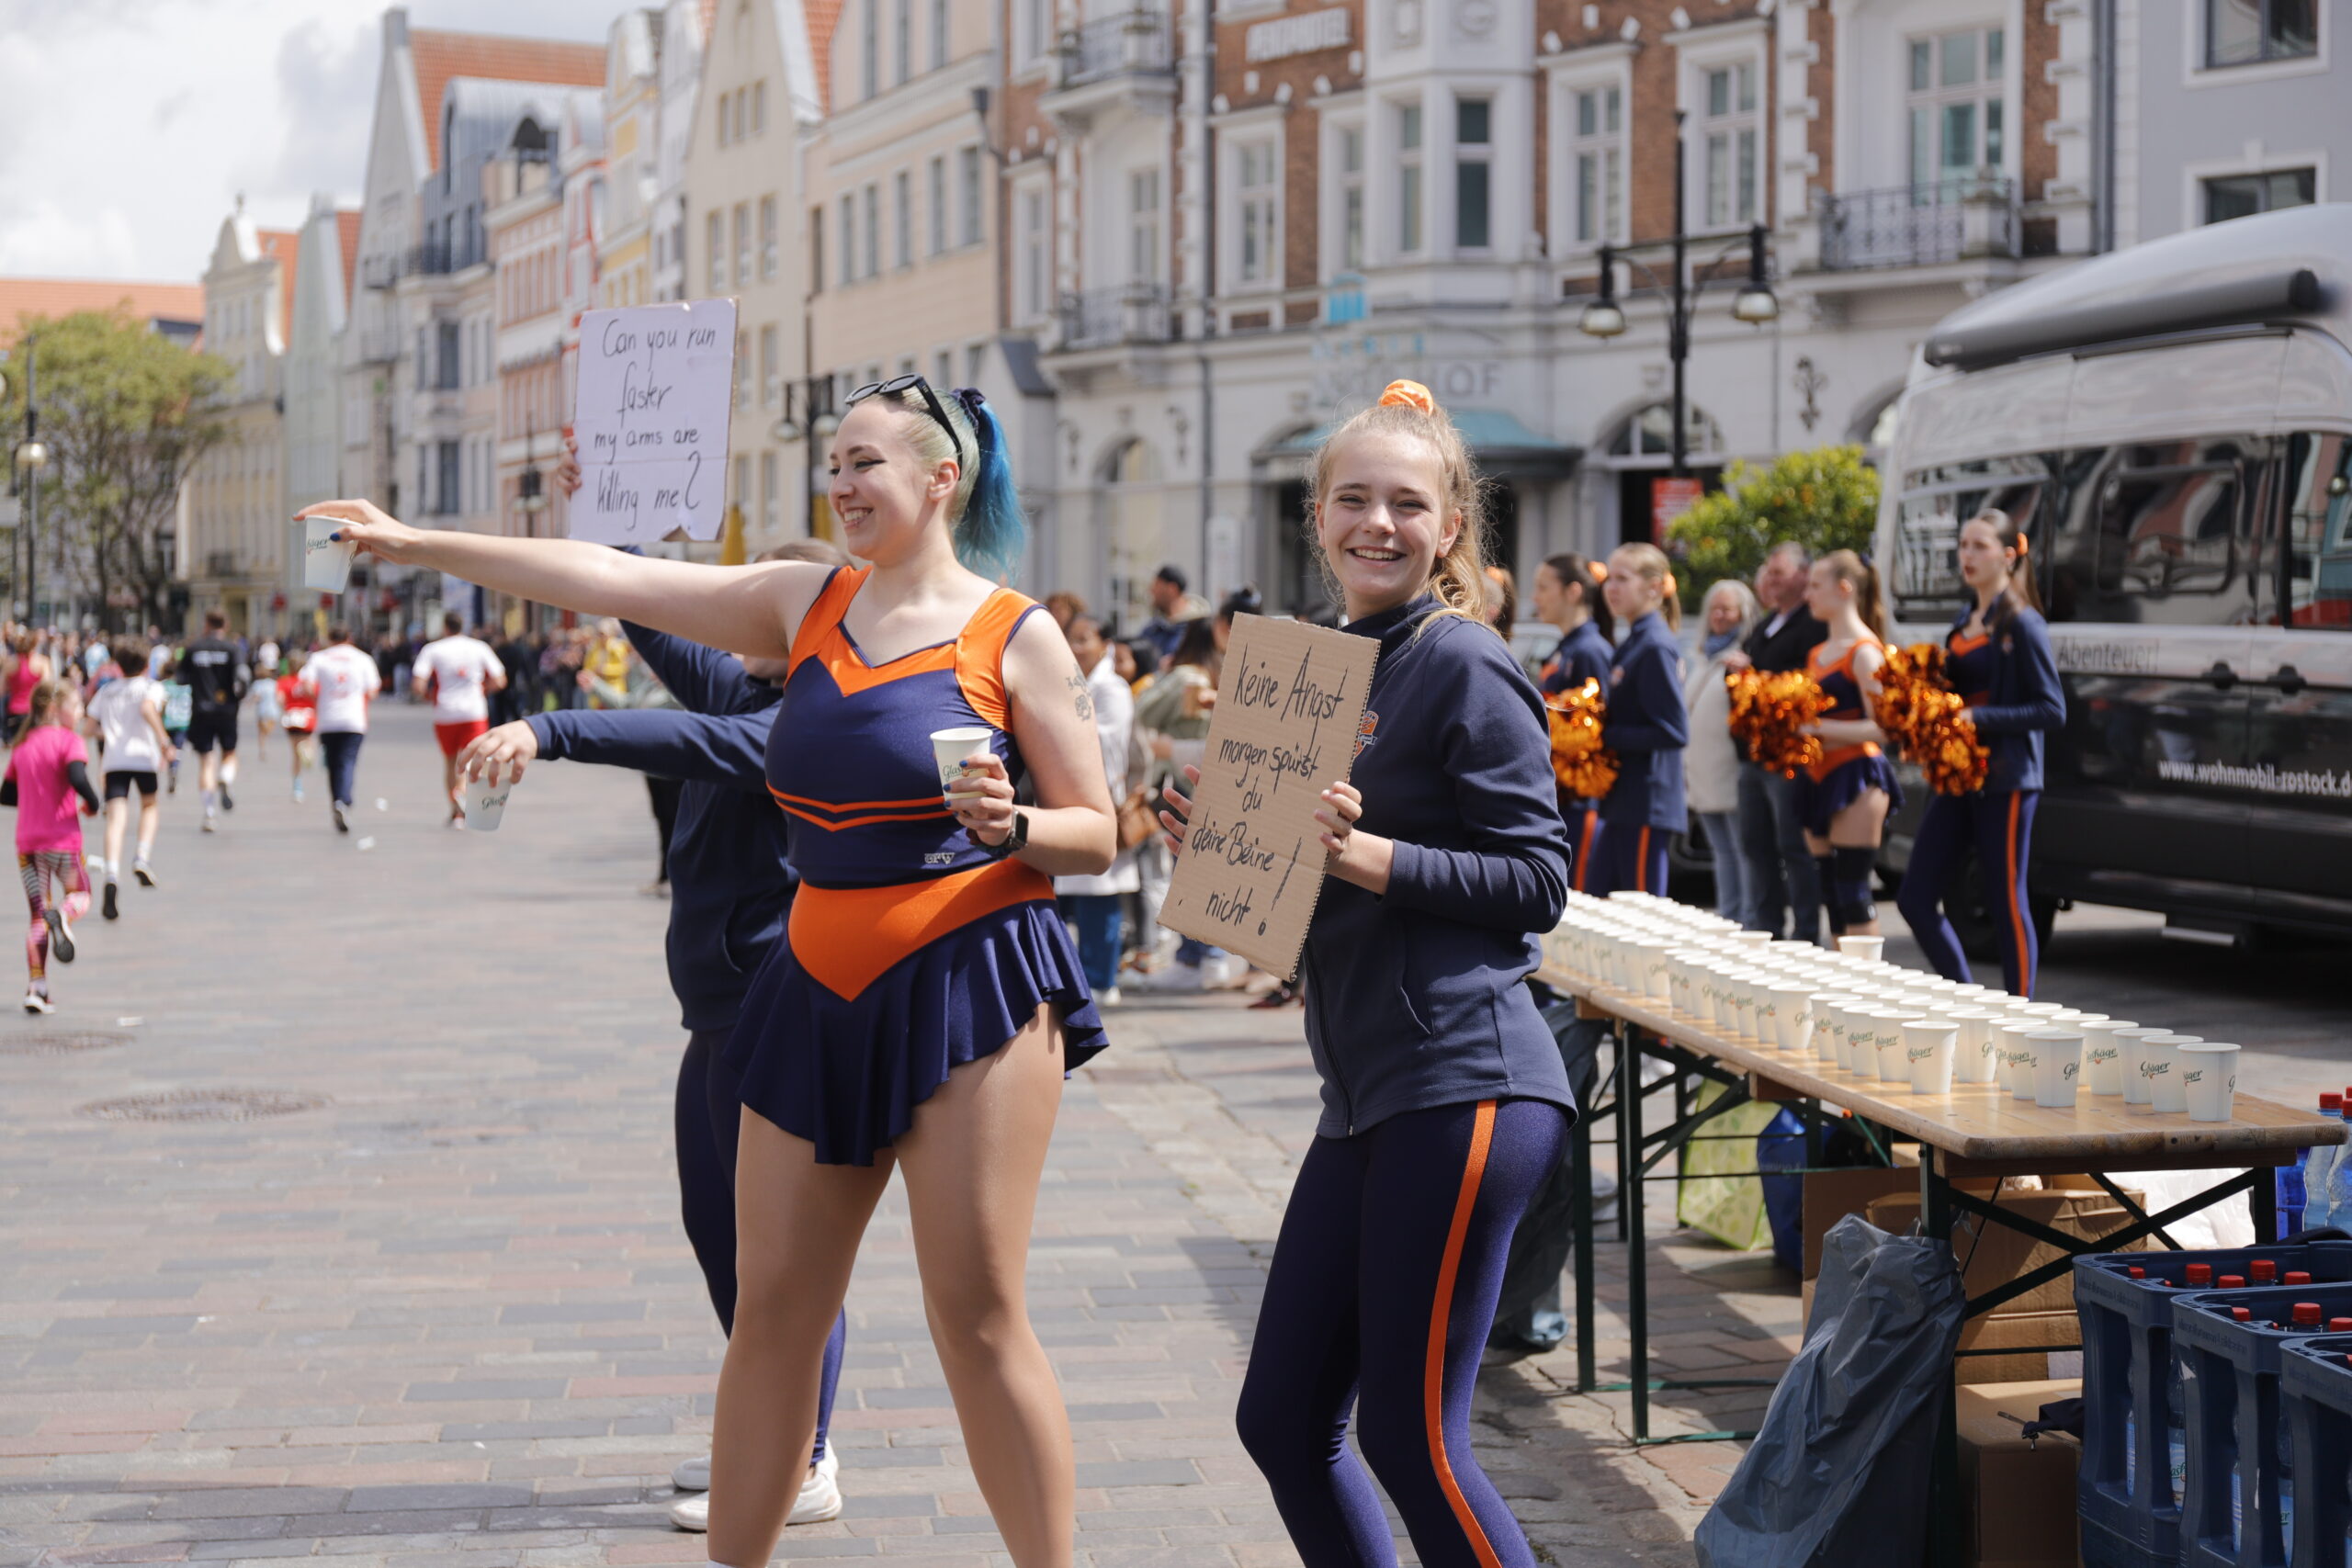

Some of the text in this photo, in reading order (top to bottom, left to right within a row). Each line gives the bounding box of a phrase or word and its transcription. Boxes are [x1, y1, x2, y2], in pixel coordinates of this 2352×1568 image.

[602, 319, 716, 371] Can you run
[616, 361, 673, 428] faster
[595, 427, 699, 466] my arms are
[596, 468, 639, 532] killing
[1280, 644, 1349, 757] Angst
[1218, 738, 1267, 788] morgen
[2158, 759, 2352, 795] www.wohnmobil-rostock.d
[1242, 776, 1263, 812] du
[1192, 806, 1274, 872] deine Beine
